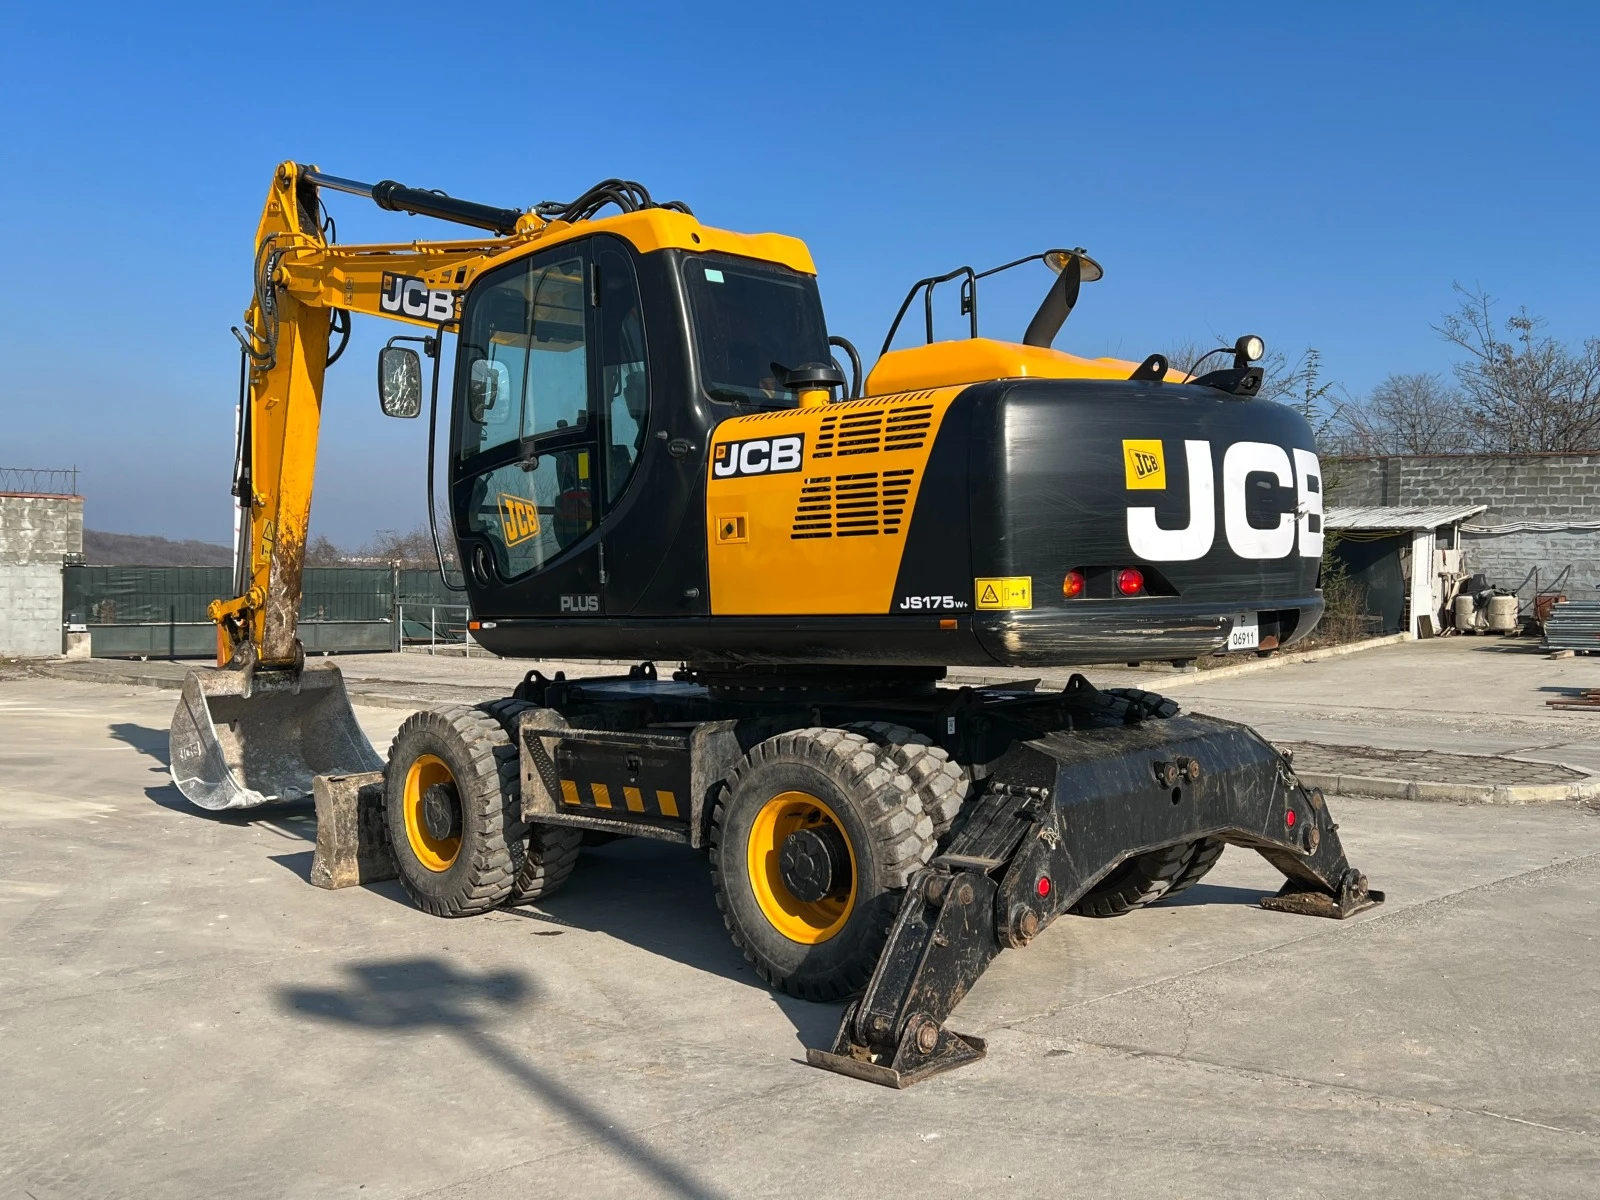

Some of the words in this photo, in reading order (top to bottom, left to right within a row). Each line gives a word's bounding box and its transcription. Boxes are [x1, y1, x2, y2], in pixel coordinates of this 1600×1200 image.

[382, 278, 455, 321] JCB
[715, 437, 802, 477] JCB
[1134, 452, 1159, 476] JCB
[504, 498, 538, 541] JCB
[1127, 439, 1325, 562] JCB
[560, 595, 599, 612] PLUS
[1233, 632, 1254, 646] 06911
